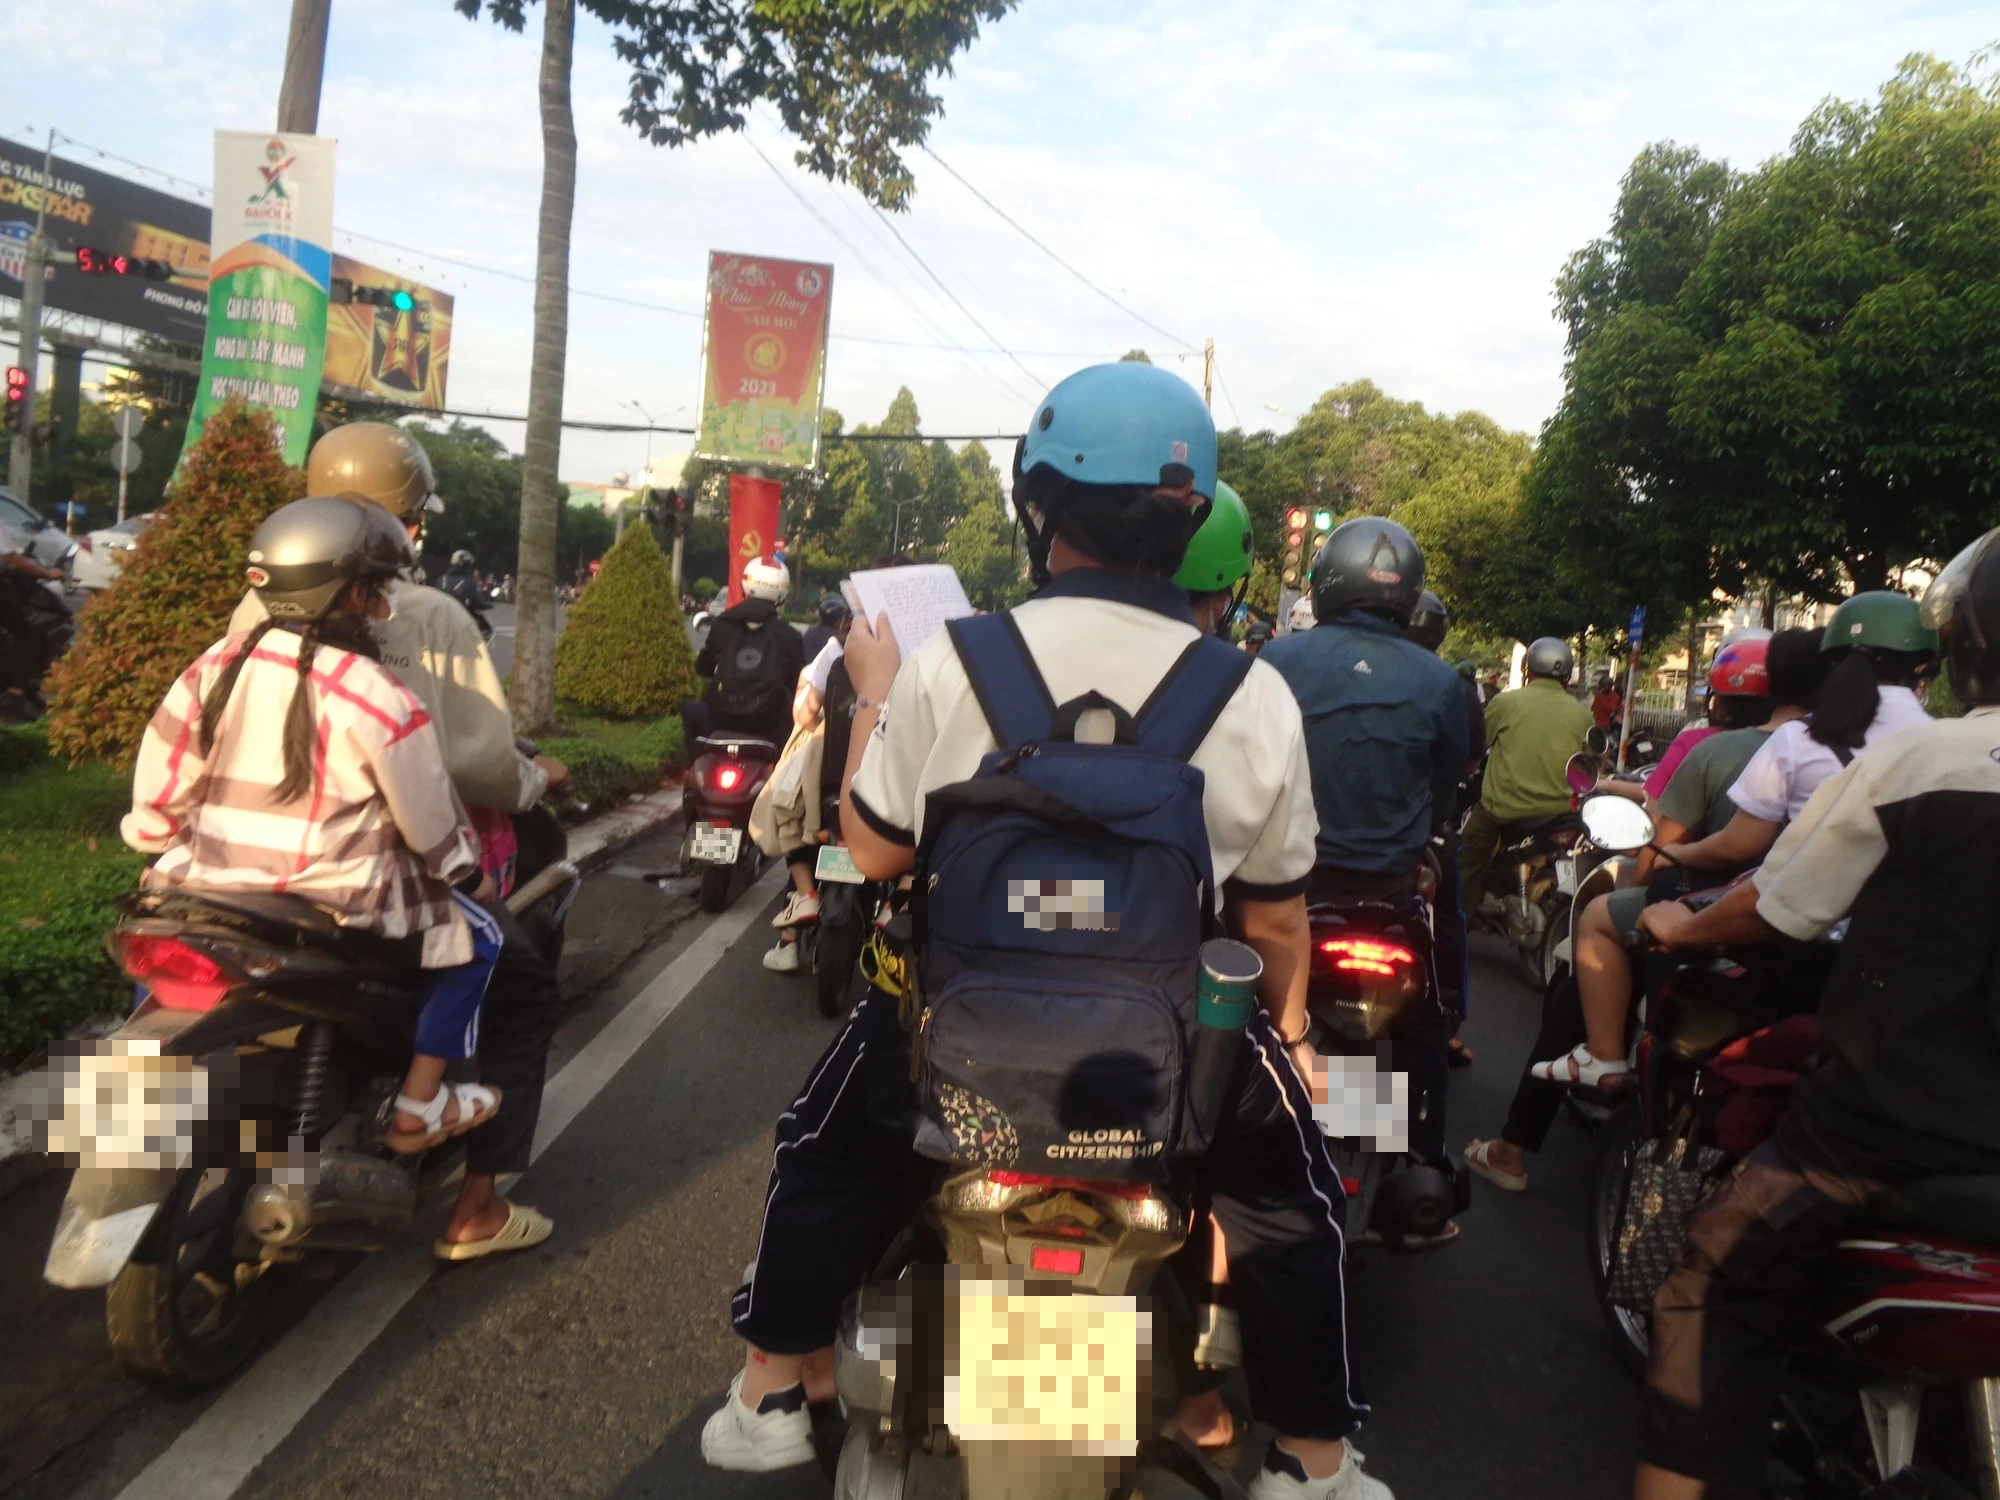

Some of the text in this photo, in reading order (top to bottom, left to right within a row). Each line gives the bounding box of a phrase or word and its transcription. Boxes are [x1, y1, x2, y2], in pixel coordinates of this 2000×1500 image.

[144, 287, 184, 309] PHONG
[738, 377, 778, 398] 2023
[1068, 1128, 1147, 1144] GLOBAL
[1045, 1140, 1164, 1160] CITIZENSHIP
